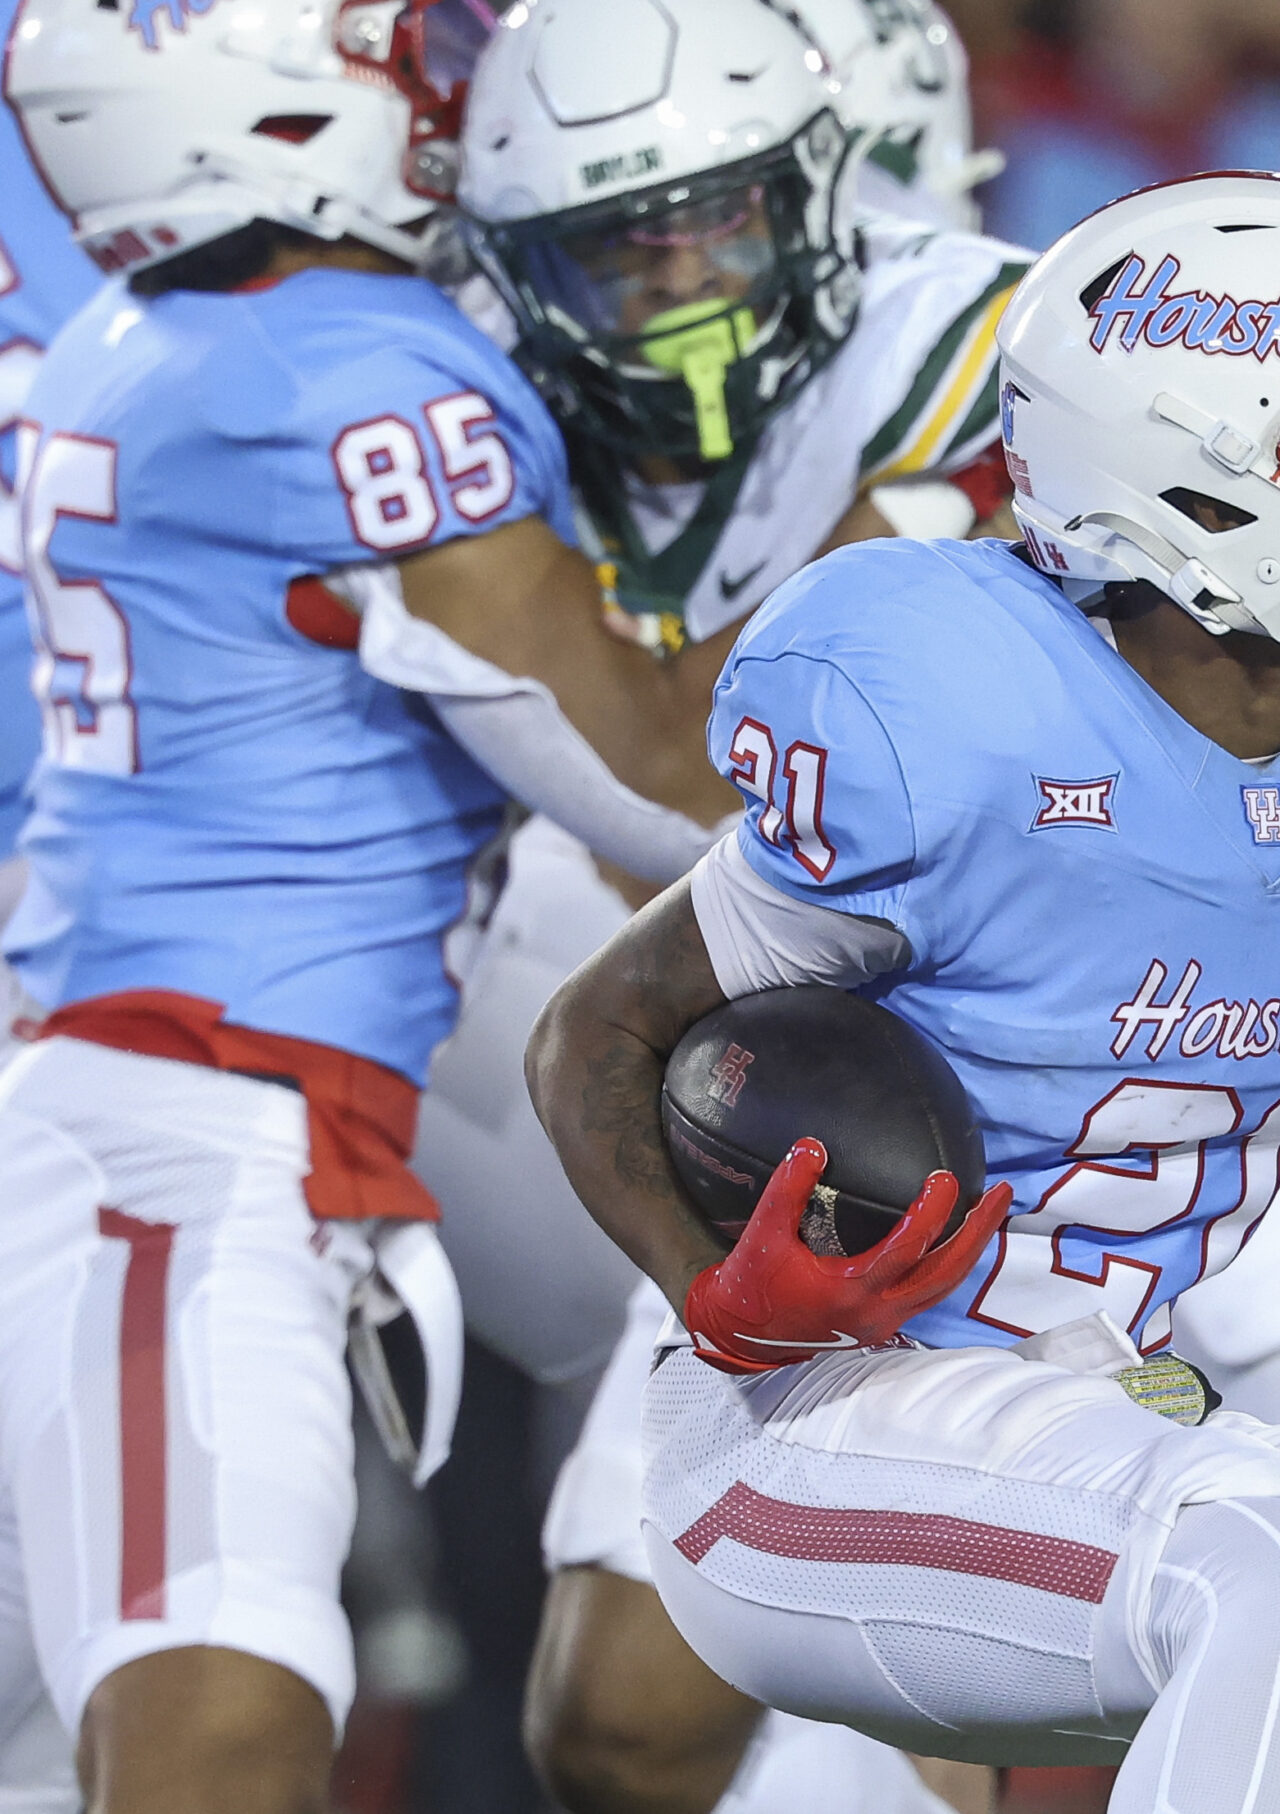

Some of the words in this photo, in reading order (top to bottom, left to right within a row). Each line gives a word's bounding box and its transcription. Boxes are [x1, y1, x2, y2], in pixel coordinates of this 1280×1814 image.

[331, 391, 515, 551] 85
[728, 715, 837, 883] 21
[1041, 784, 1108, 821] XII
